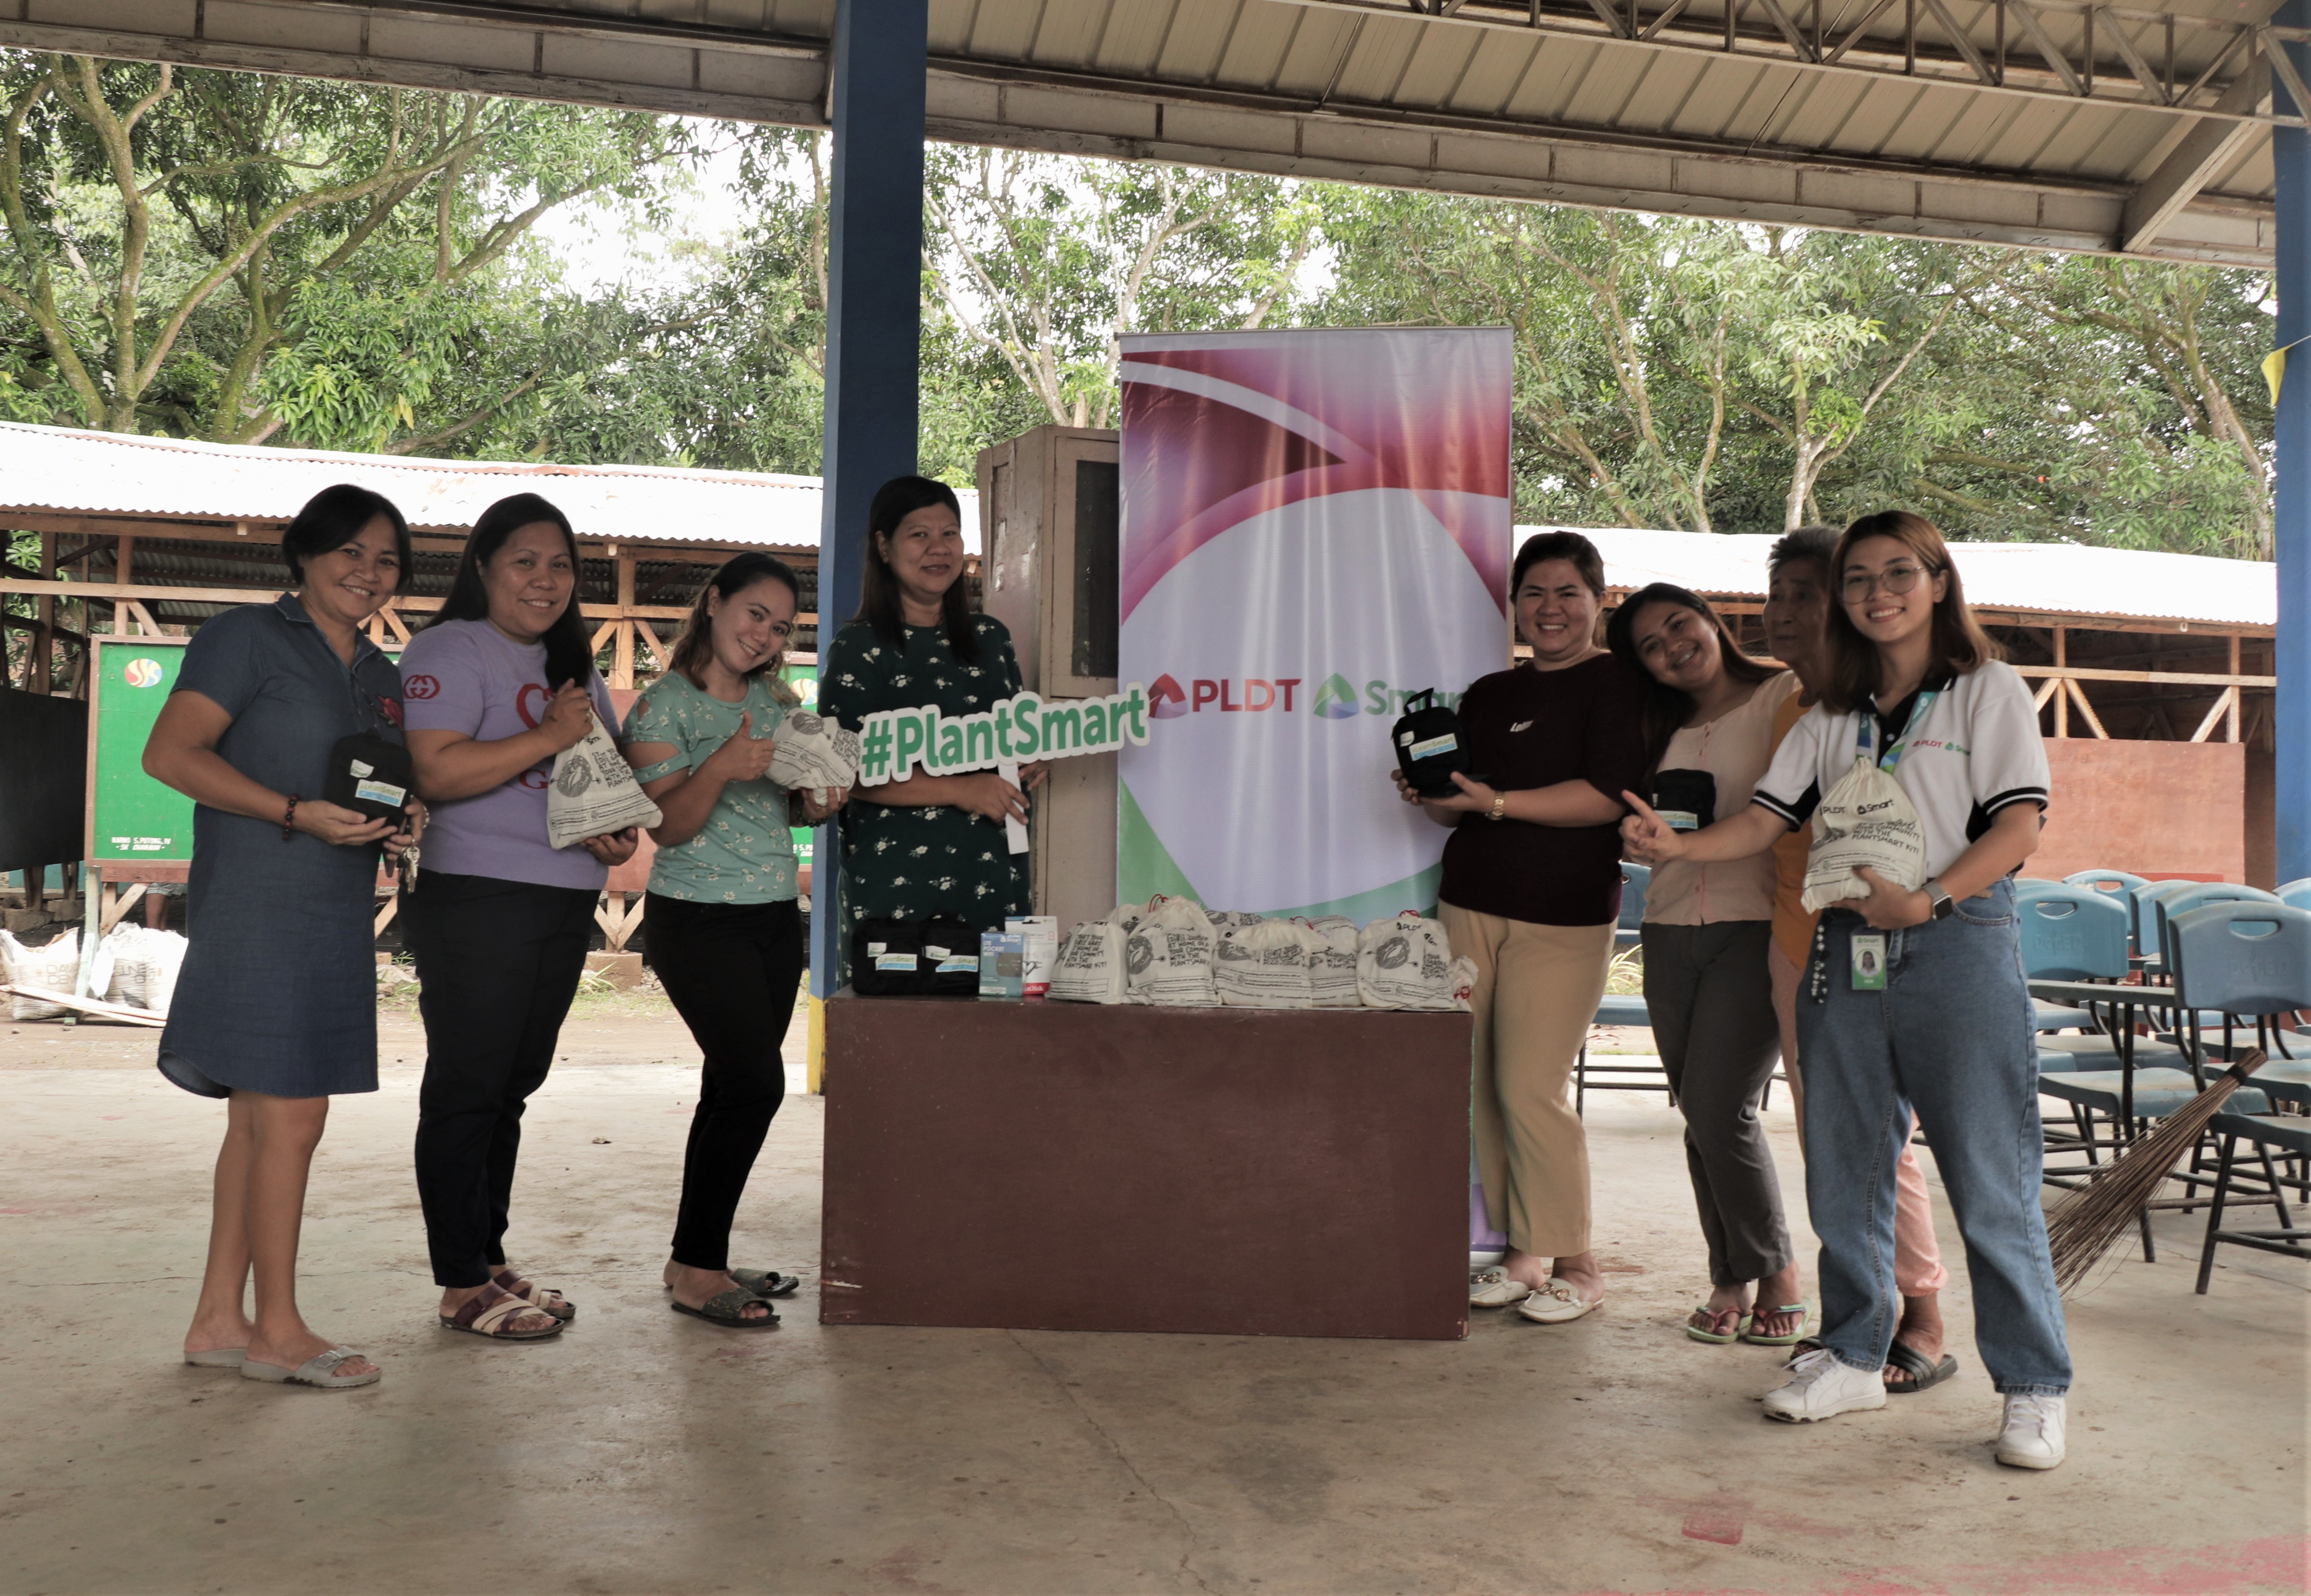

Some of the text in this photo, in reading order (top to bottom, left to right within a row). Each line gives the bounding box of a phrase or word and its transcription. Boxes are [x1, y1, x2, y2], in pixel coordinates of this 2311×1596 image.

[1192, 678, 1302, 713] PLDT
[1365, 679, 1475, 715] Smar
[862, 689, 1146, 778] #PlantSmart
[1920, 740, 1943, 748] PLDT
[1866, 798, 1895, 812] Smart
[1852, 834, 1904, 848] PLANTSMART
